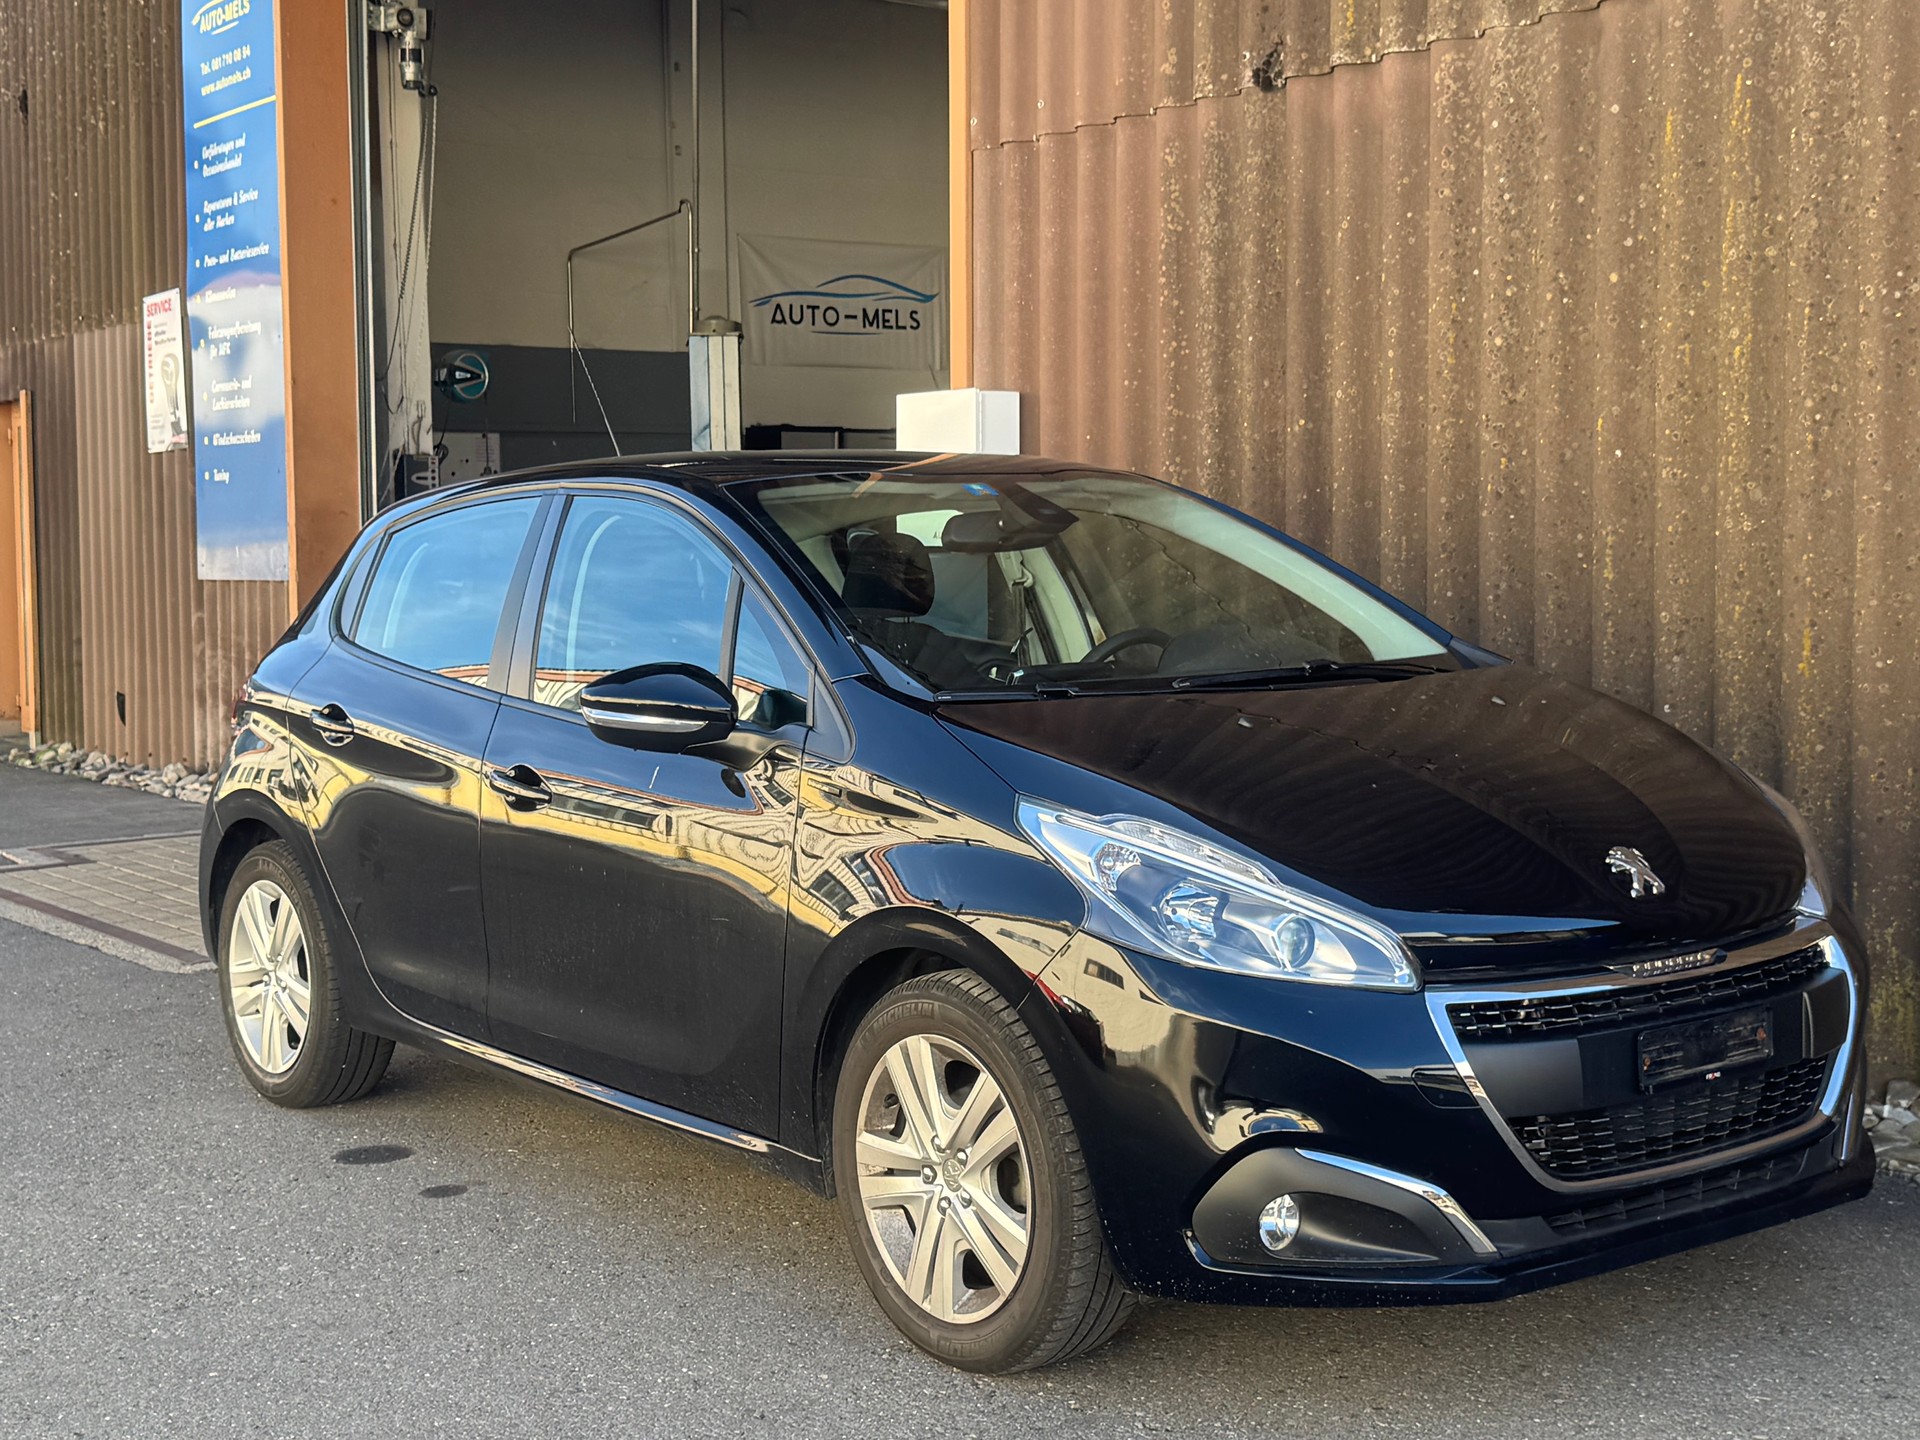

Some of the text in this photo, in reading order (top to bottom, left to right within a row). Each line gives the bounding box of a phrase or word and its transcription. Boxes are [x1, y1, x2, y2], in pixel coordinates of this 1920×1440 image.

[200, 0, 251, 34] AUTO-MELS
[146, 297, 173, 318] SERVICE
[873, 1002, 935, 1032] MICHELIN
